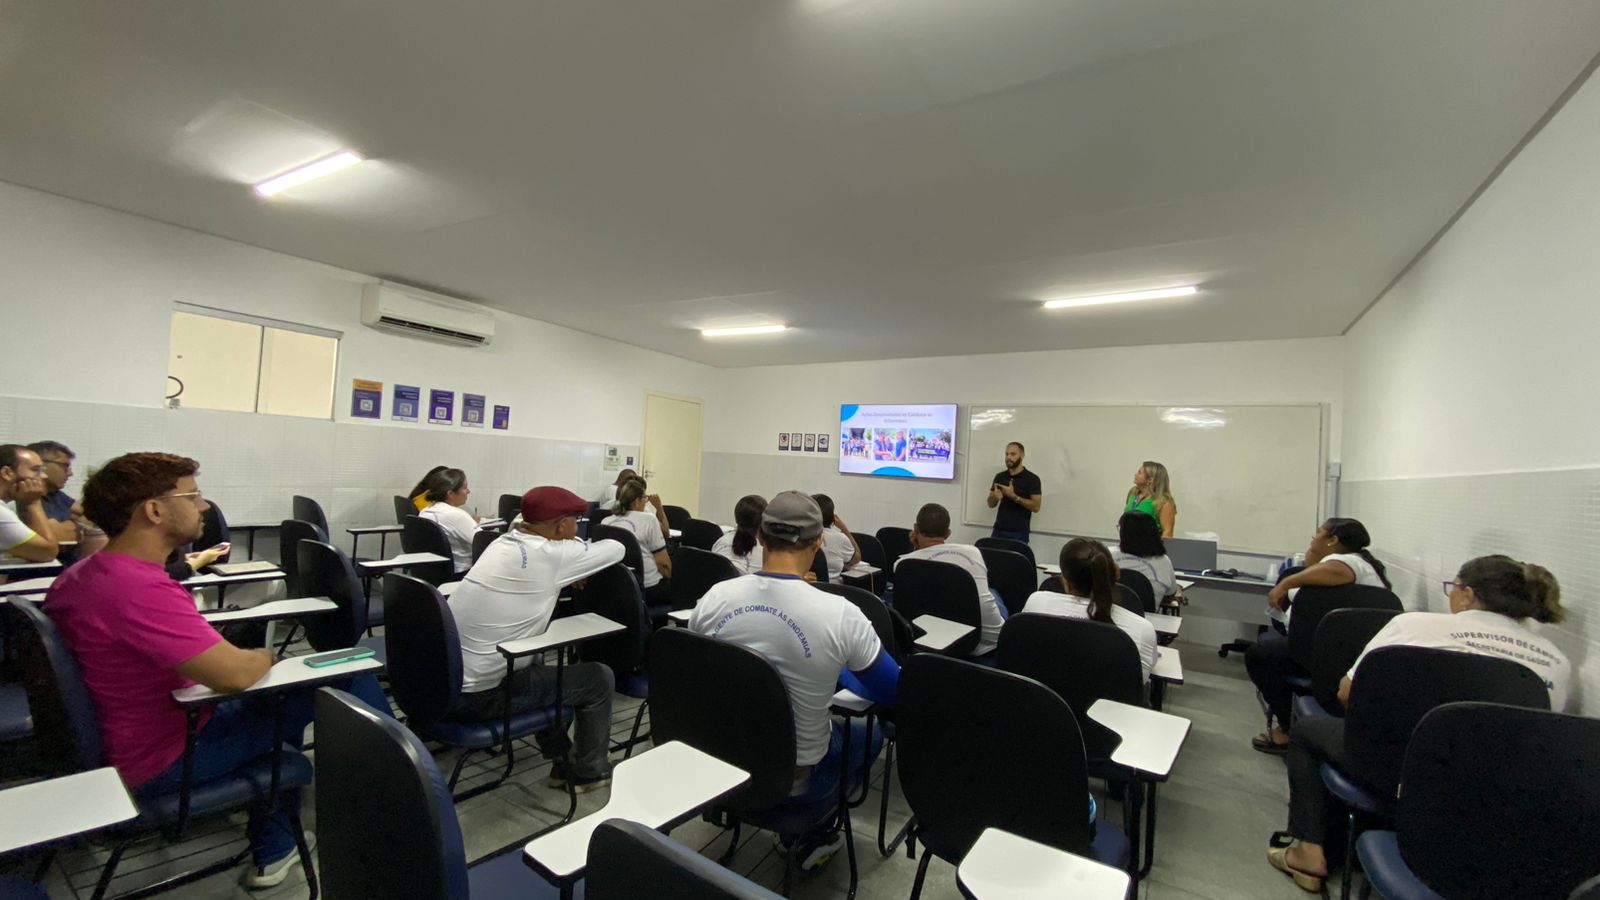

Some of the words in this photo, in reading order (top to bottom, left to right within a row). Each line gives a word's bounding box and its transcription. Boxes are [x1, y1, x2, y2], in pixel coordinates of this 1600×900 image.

[734, 607, 744, 616] DE
[745, 605, 777, 615] COMBATE
[778, 610, 788, 622] ÀS
[788, 619, 811, 658] ENDEMIAS
[1450, 632, 1514, 644] SUPERVISOR
[1515, 639, 1529, 650] DE
